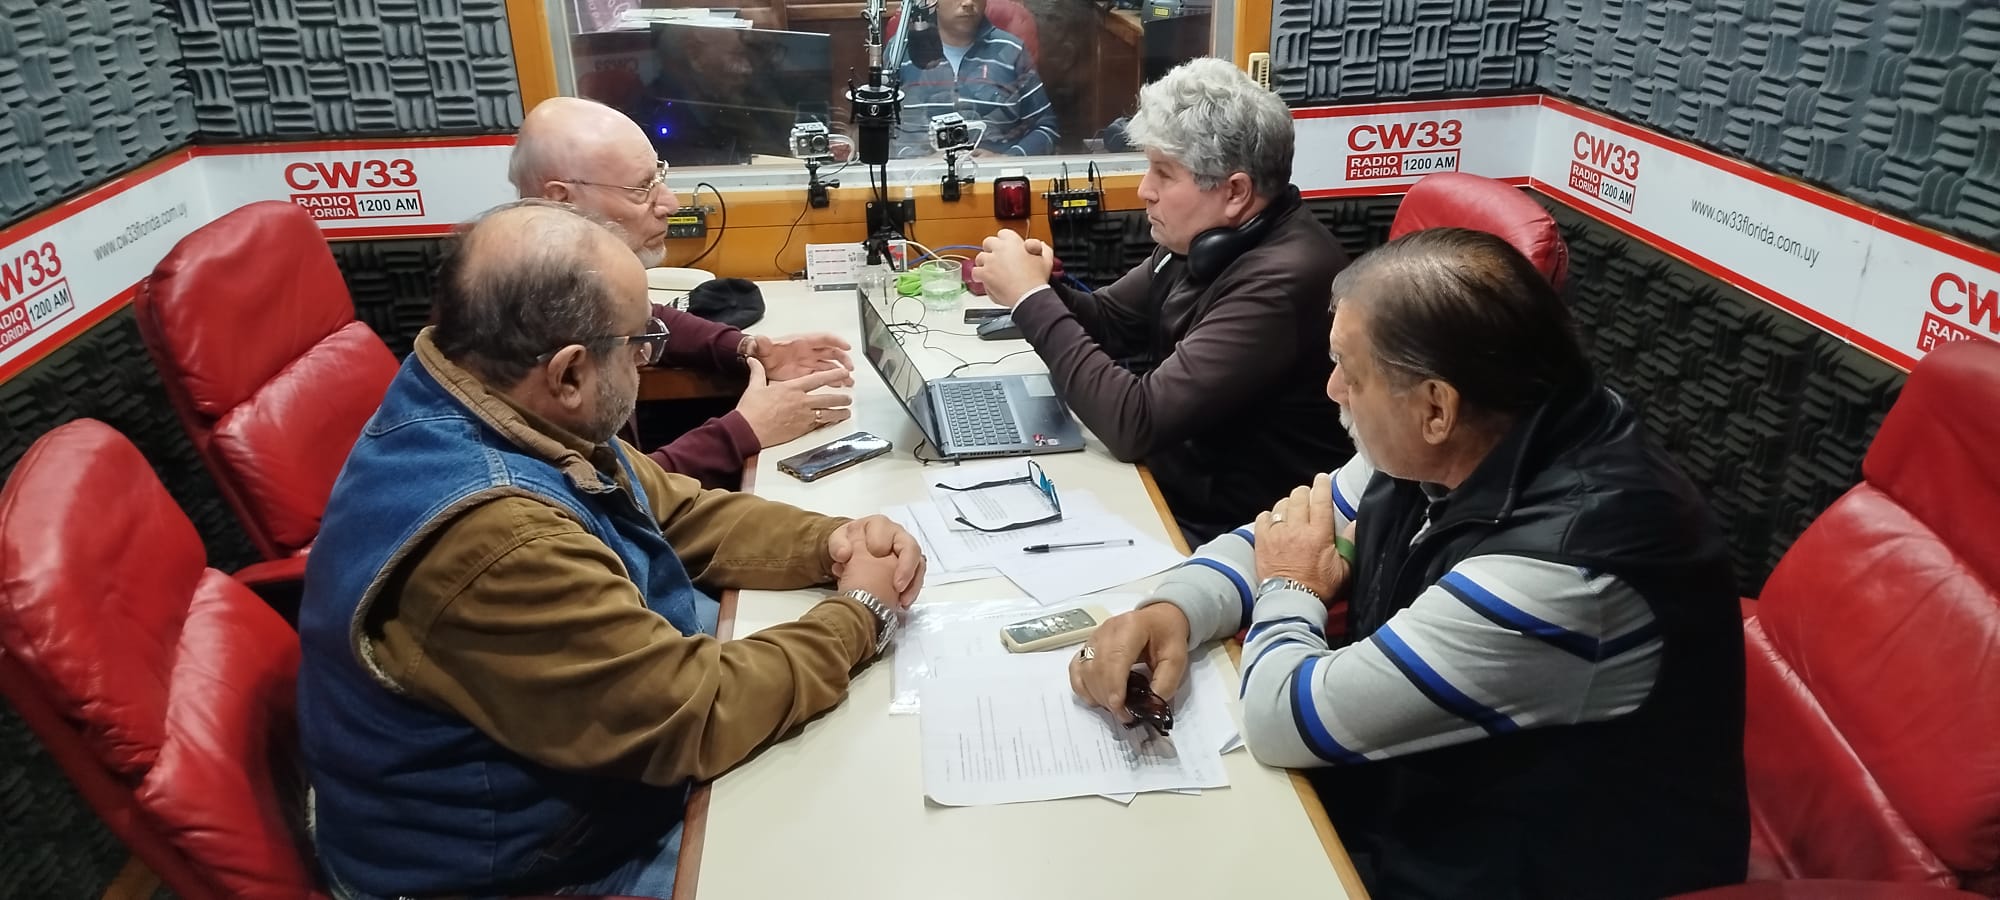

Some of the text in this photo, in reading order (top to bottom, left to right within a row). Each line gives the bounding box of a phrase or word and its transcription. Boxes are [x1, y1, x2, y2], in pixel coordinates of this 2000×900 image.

[1347, 119, 1463, 152] CW33
[1350, 155, 1399, 168] RADIO
[1403, 156, 1456, 171] 1200 AM
[1573, 131, 1640, 181] CW33
[284, 158, 418, 191] CW33
[1350, 166, 1399, 179] FLORIDA
[1572, 164, 1600, 184] RADIO
[1571, 176, 1599, 196] FLORIDA
[1601, 182, 1632, 206] 1200 AM
[295, 195, 351, 208] RADIO
[358, 197, 419, 213] 1200 AM
[1691, 198, 1821, 269] www.cw33florida.com.uy
[0, 241, 62, 302] W33
[29, 287, 70, 323] 1200 AM
[1930, 272, 2000, 335] CW
